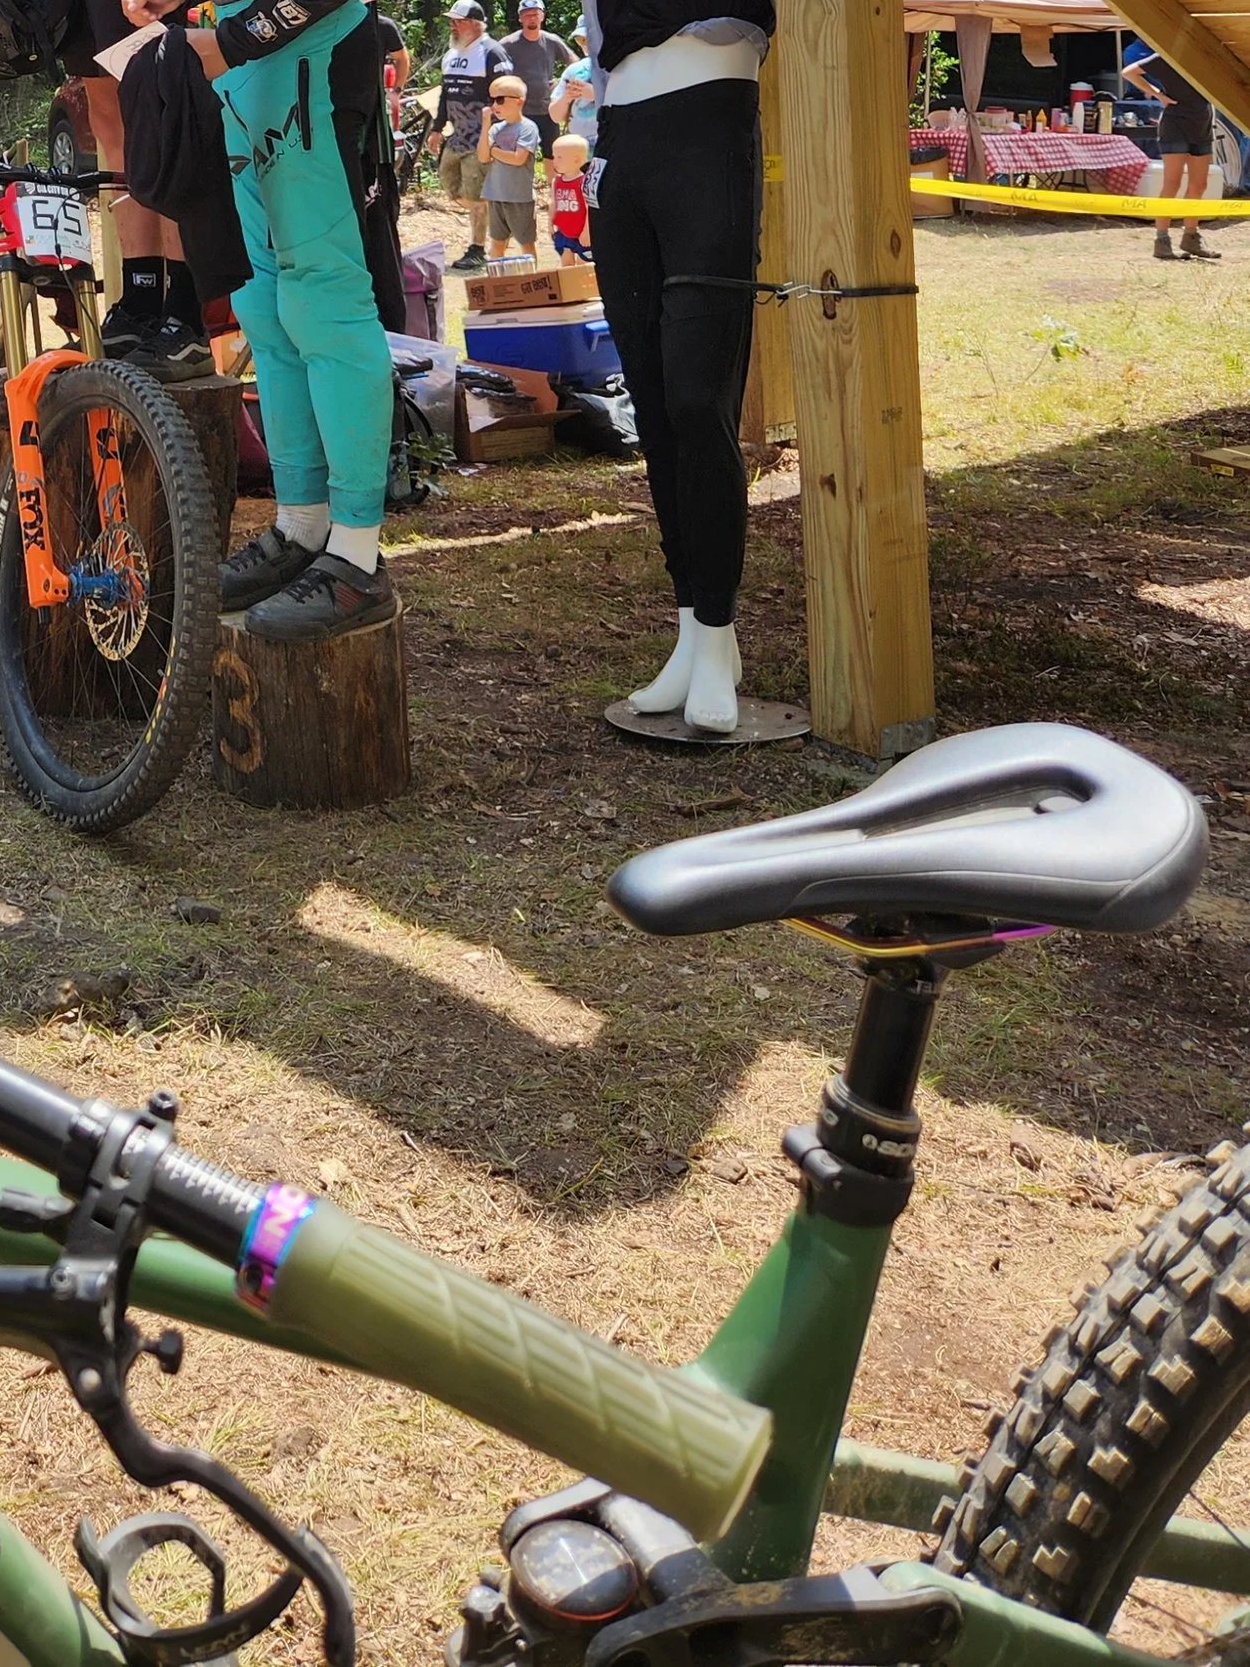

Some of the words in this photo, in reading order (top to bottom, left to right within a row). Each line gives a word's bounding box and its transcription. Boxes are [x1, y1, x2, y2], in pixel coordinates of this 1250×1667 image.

[32, 199, 82, 236] 65
[19, 487, 46, 555] FOX
[214, 649, 264, 775] 3
